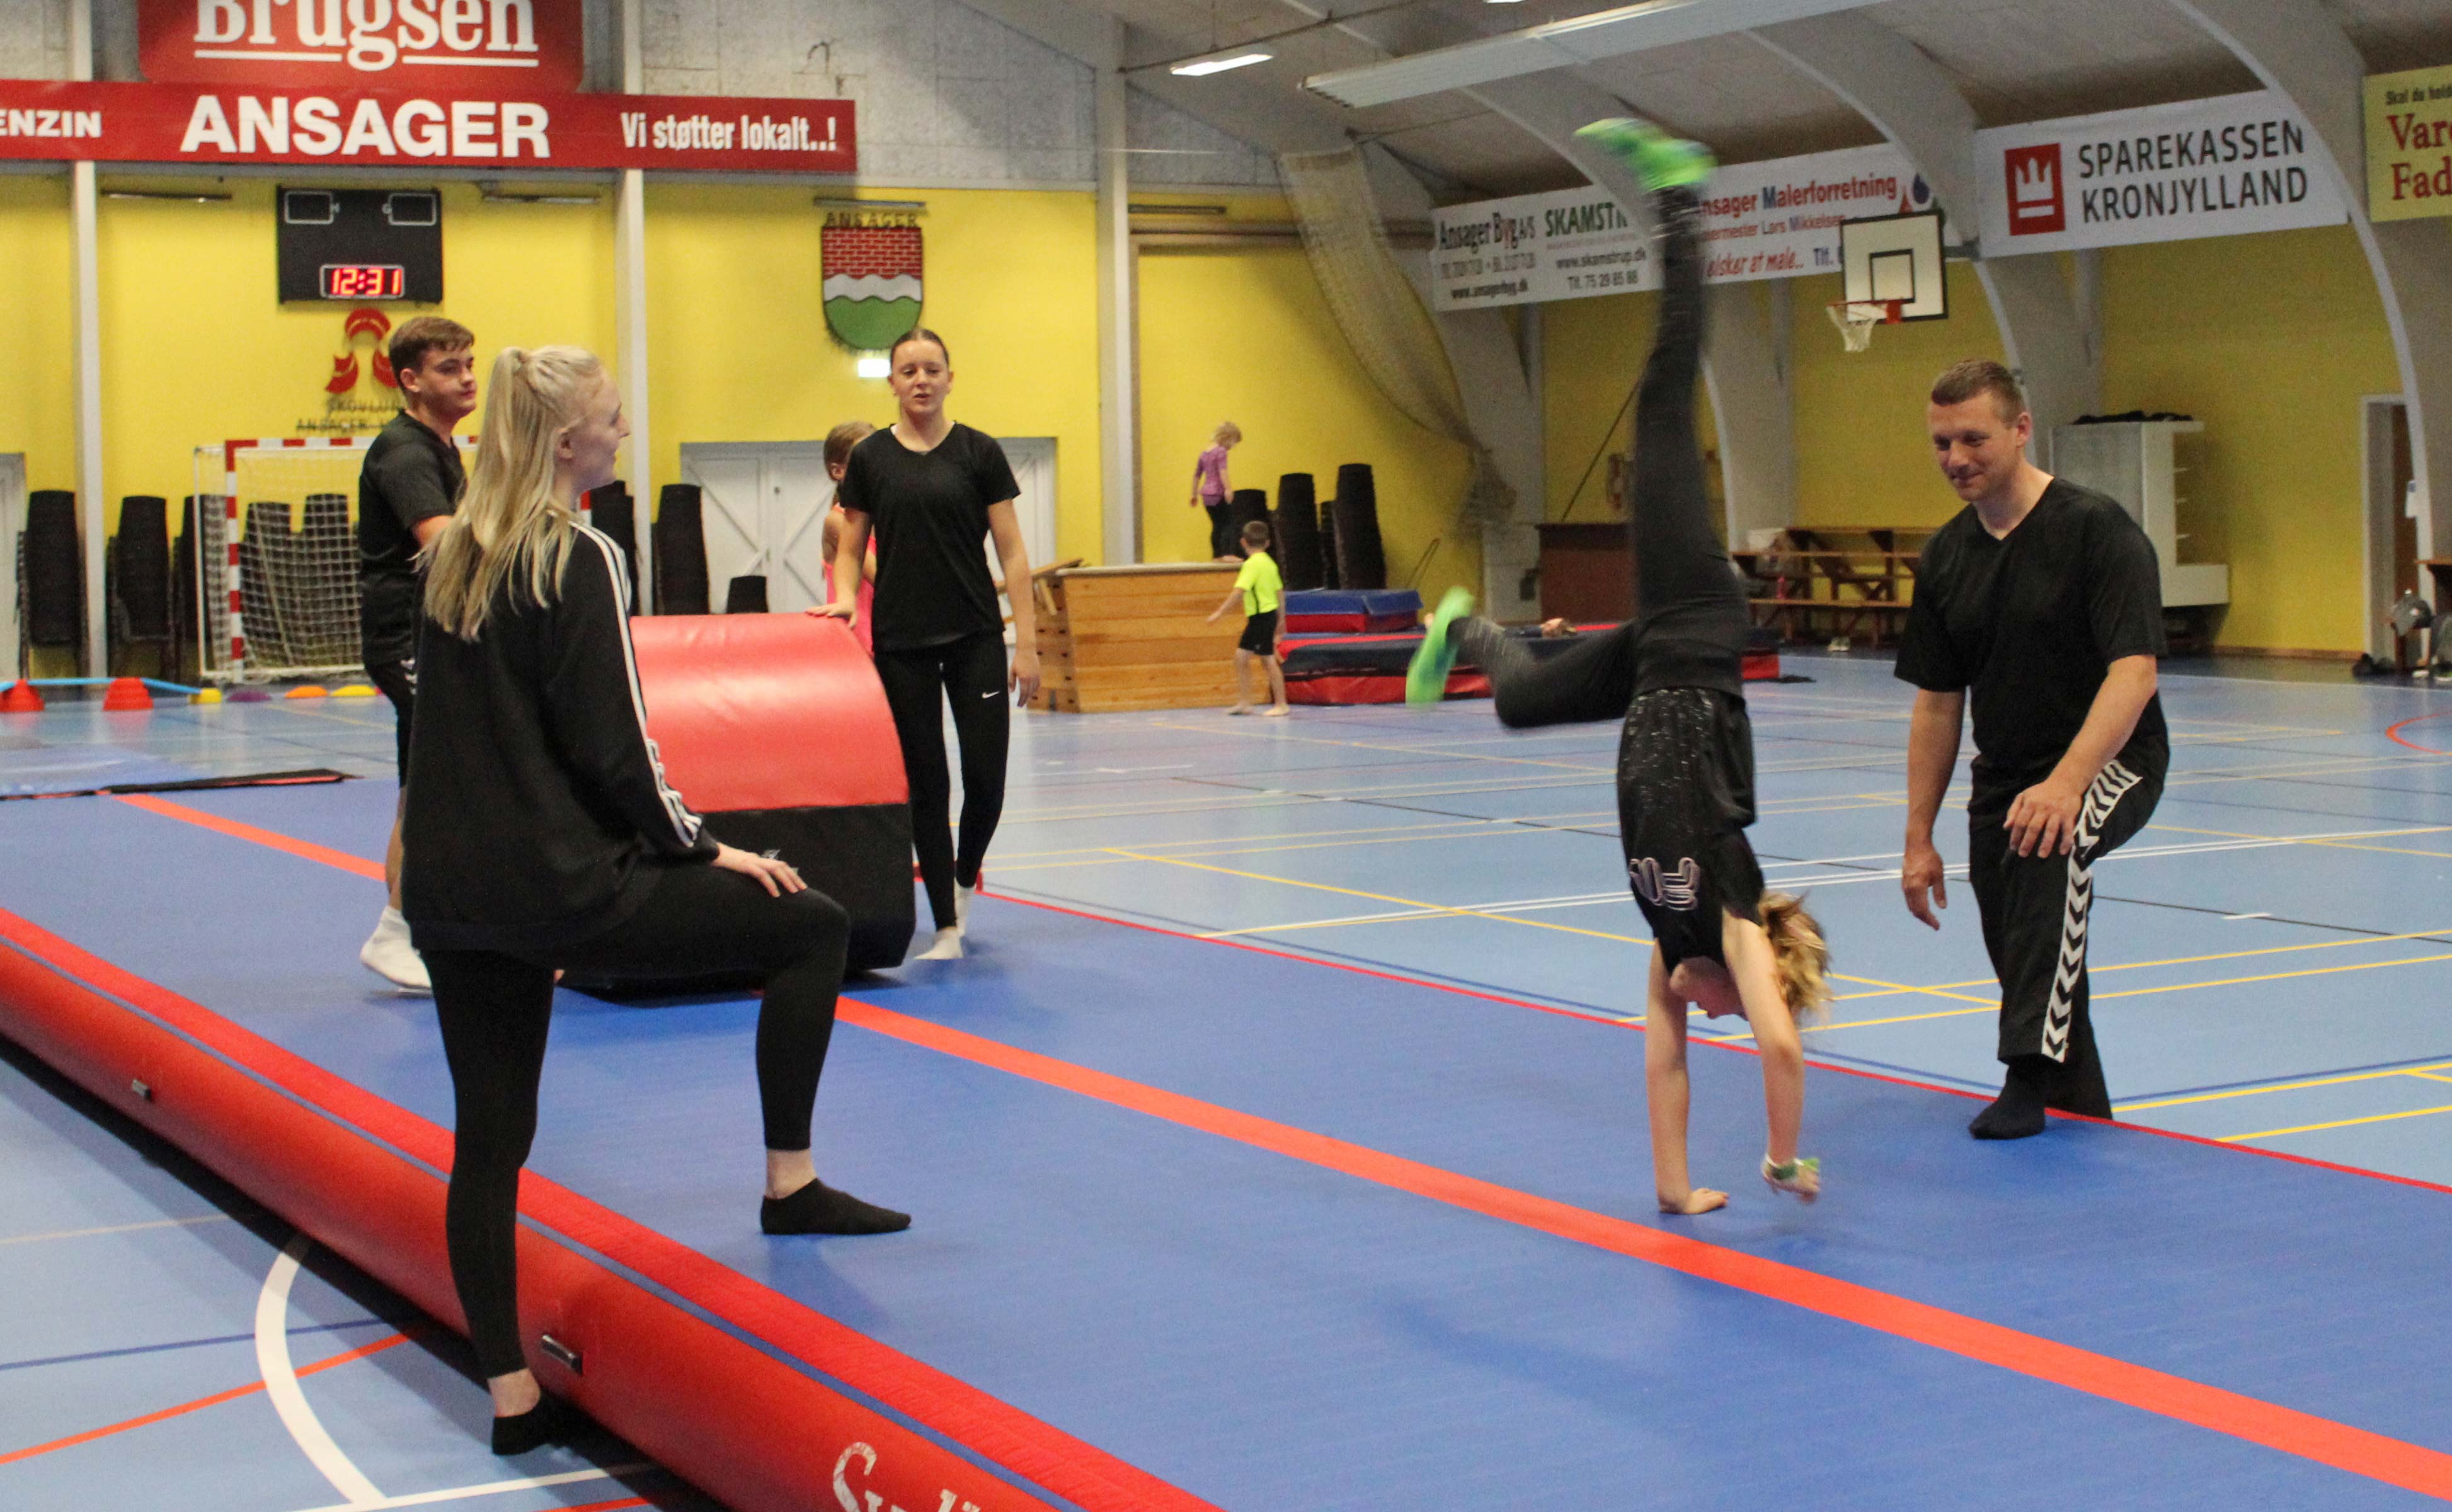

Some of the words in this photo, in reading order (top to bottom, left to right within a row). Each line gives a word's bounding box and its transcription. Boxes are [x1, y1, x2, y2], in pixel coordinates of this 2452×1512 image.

[180, 94, 550, 158] ANSAGER
[621, 112, 646, 148] Vi
[653, 114, 735, 151] støtter
[2078, 120, 2305, 178] SPAREKASSEN
[1695, 194, 1757, 219] nsager
[1763, 173, 1896, 210] Malerforretning
[2082, 166, 2308, 223] KRONJYLLAND
[331, 266, 403, 296] 12:31
